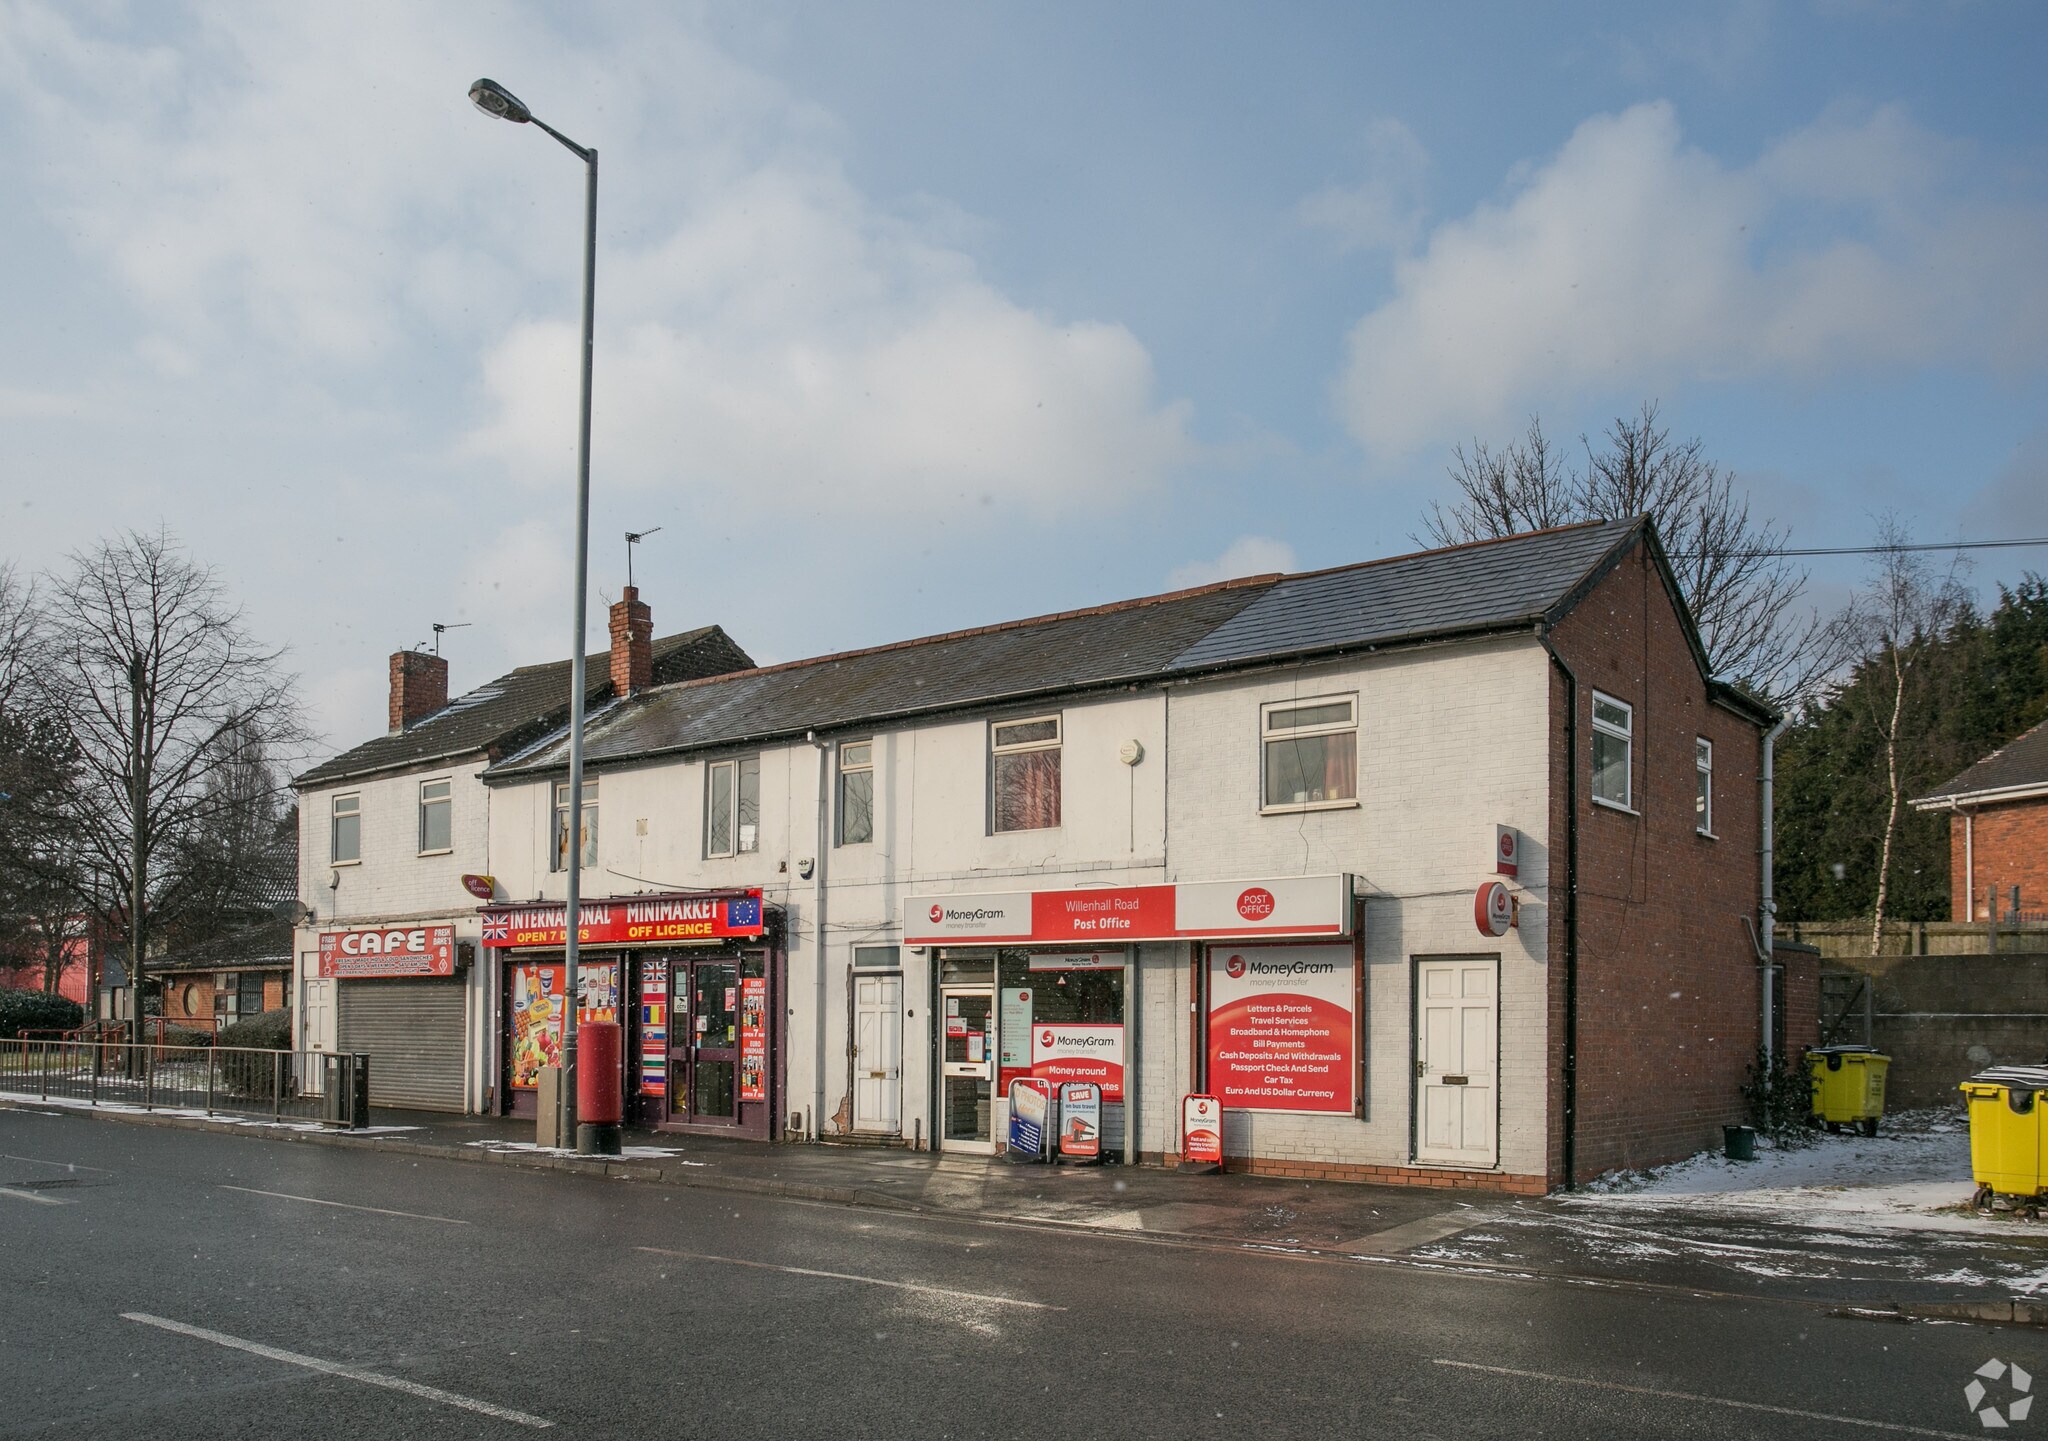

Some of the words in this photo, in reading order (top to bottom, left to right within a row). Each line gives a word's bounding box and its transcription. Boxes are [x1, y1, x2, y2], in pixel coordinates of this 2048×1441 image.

[1244, 894, 1267, 904] POST
[1066, 899, 1111, 912] Willenhall
[1115, 898, 1139, 910] Road
[1240, 904, 1270, 914] OFFICE
[510, 905, 611, 929] INTERNATONAL
[627, 899, 719, 923] MINIMARKET
[946, 909, 1004, 922] MoneyGram
[1074, 918, 1096, 929] Post
[1100, 918, 1130, 928] Office
[517, 932, 547, 942] OPEN
[550, 931, 556, 940] 7
[560, 929, 589, 940] DYS
[628, 926, 652, 938] OFF
[656, 923, 712, 936] LICENCE
[341, 929, 425, 955] CAFE
[1250, 961, 1334, 977] MoneyGram
[754, 1029, 758, 1037] 7
[1281, 1029, 1329, 1037] Homephone
[1057, 1036, 1114, 1047] MoneyGram
[1266, 1041, 1305, 1049] Payments
[1240, 1052, 1272, 1060] Deposits
[1048, 1066, 1075, 1076] Money
[1077, 1067, 1106, 1076] around
[1231, 1064, 1264, 1072] Passport
[1071, 1091, 1089, 1100] SAVE
[1297, 1089, 1334, 1099] Currency
[1021, 1090, 1044, 1109] PHOTOS
